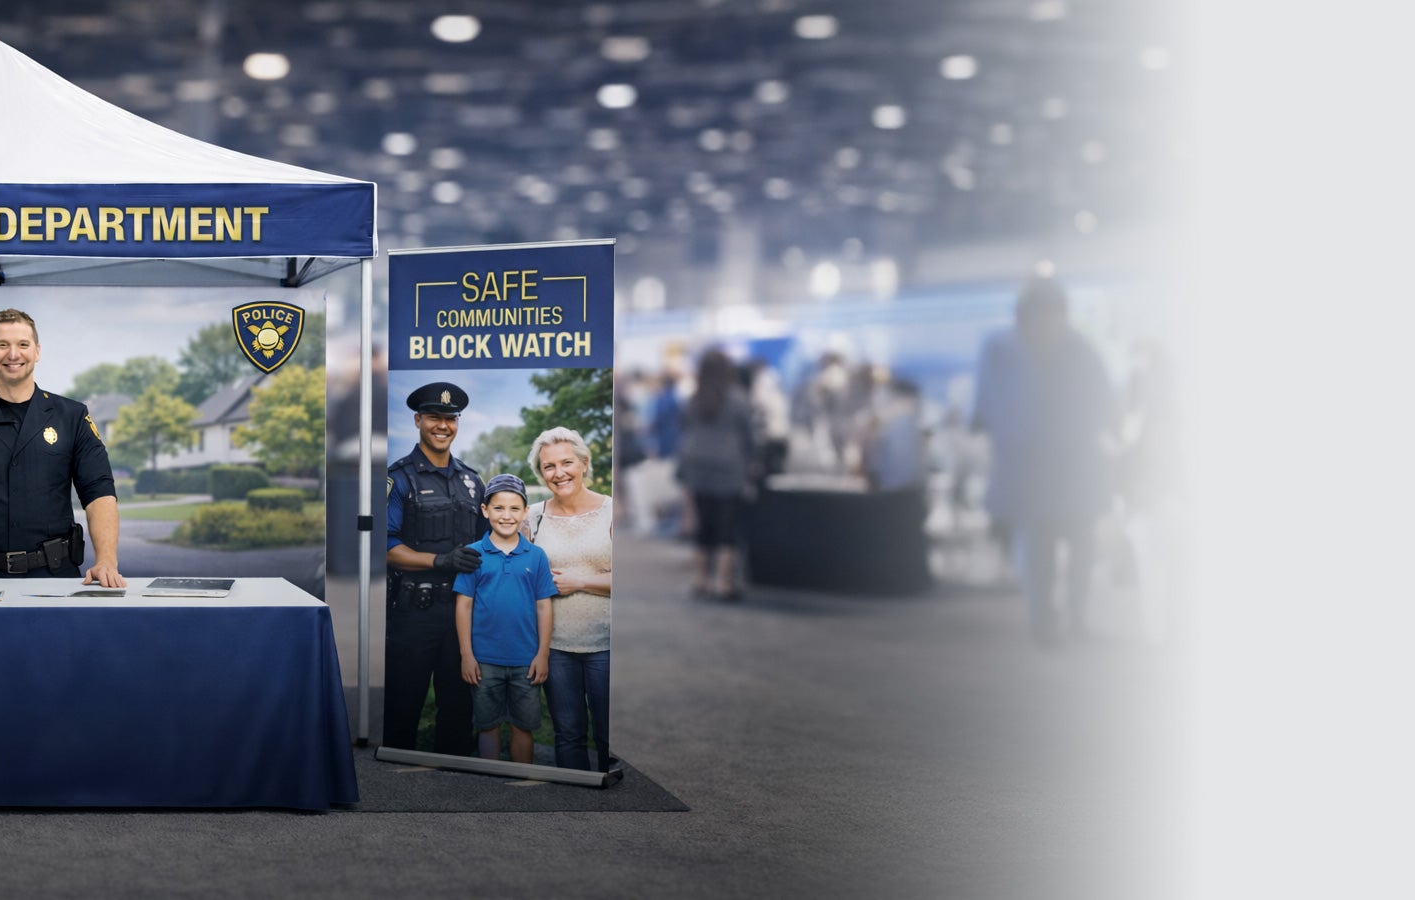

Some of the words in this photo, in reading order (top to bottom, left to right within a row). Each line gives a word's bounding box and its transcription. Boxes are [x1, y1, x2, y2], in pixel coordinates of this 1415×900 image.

[461, 269, 539, 303] SAFE
[241, 308, 295, 324] POLICE
[436, 306, 563, 328] COMMUNITIES
[409, 333, 492, 360] BLOCK
[499, 331, 592, 358] WATCH
